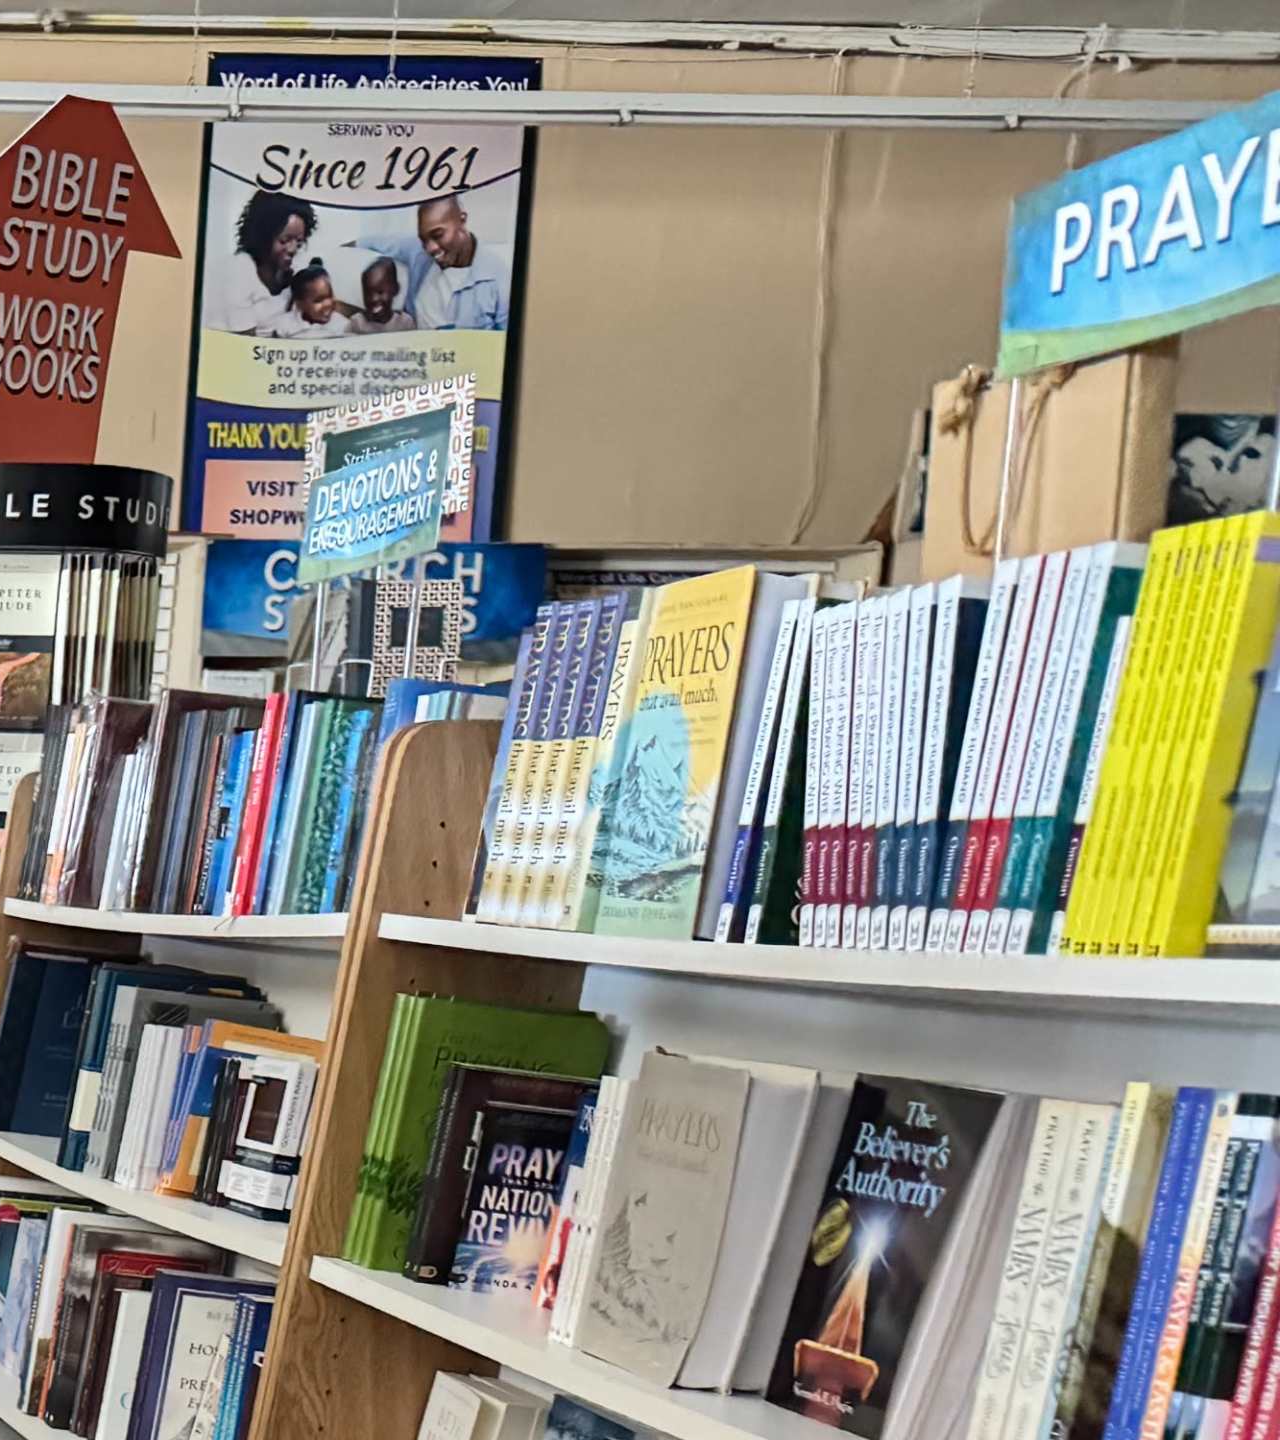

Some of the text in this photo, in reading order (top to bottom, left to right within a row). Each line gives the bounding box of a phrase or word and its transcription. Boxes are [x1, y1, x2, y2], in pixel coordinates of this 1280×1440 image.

[10, 144, 135, 225] BIBLE
[255, 144, 480, 193] Since 1961
[1047, 126, 1280, 295] PRAYE
[252, 345, 457, 367] Sign up for our mailing list
[276, 366, 294, 381] to
[297, 365, 355, 381] receive
[268, 381, 357, 400] and special
[208, 422, 306, 450] THANK YOU
[247, 481, 298, 497] VISIT
[313, 451, 425, 523] DEVOTIONS
[425, 449, 439, 481] &
[308, 490, 437, 556] ENCOURAGEMENT
[640, 620, 737, 686] PRAYERS
[905, 1100, 939, 1130] The
[488, 1143, 565, 1180] PRAY
[853, 1121, 952, 1170] Believer's
[835, 1158, 948, 1220] Authority
